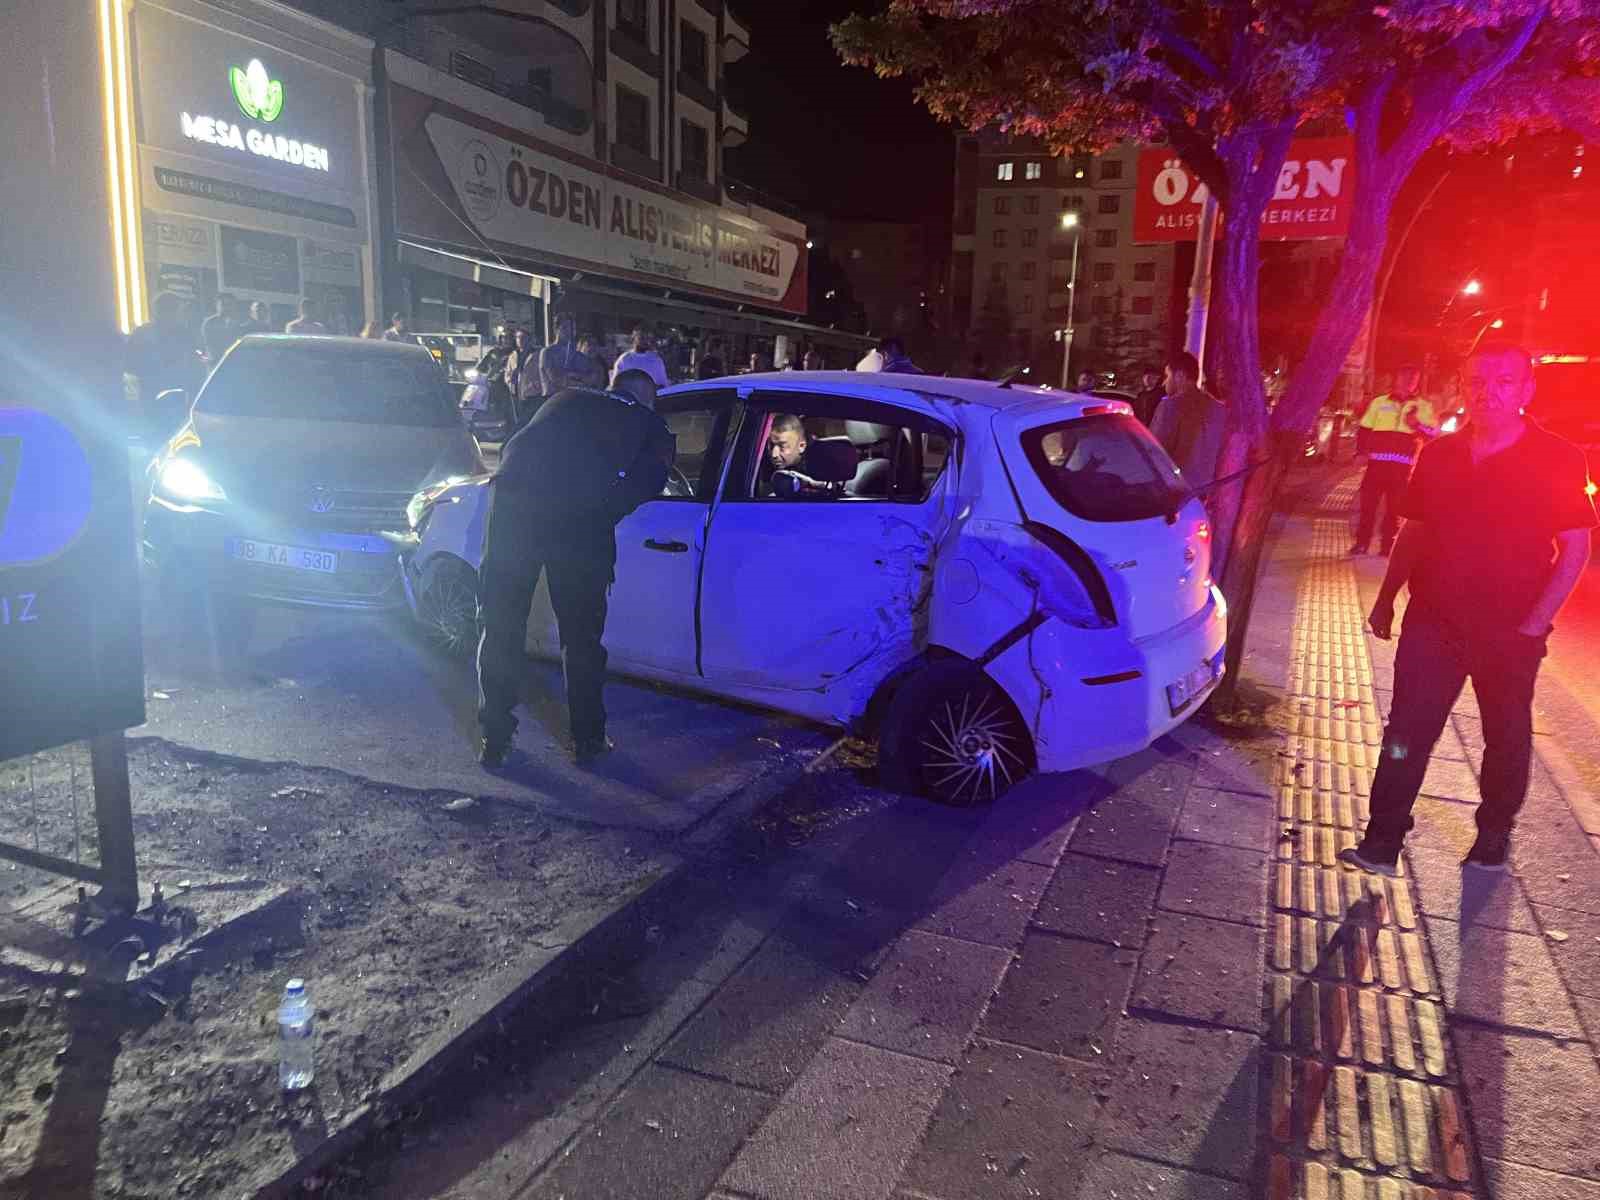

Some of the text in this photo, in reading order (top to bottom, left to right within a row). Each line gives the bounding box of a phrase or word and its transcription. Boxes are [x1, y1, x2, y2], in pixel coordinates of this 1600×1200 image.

[180, 111, 329, 172] MESA GARDEN
[506, 145, 600, 230] ÖZDEN
